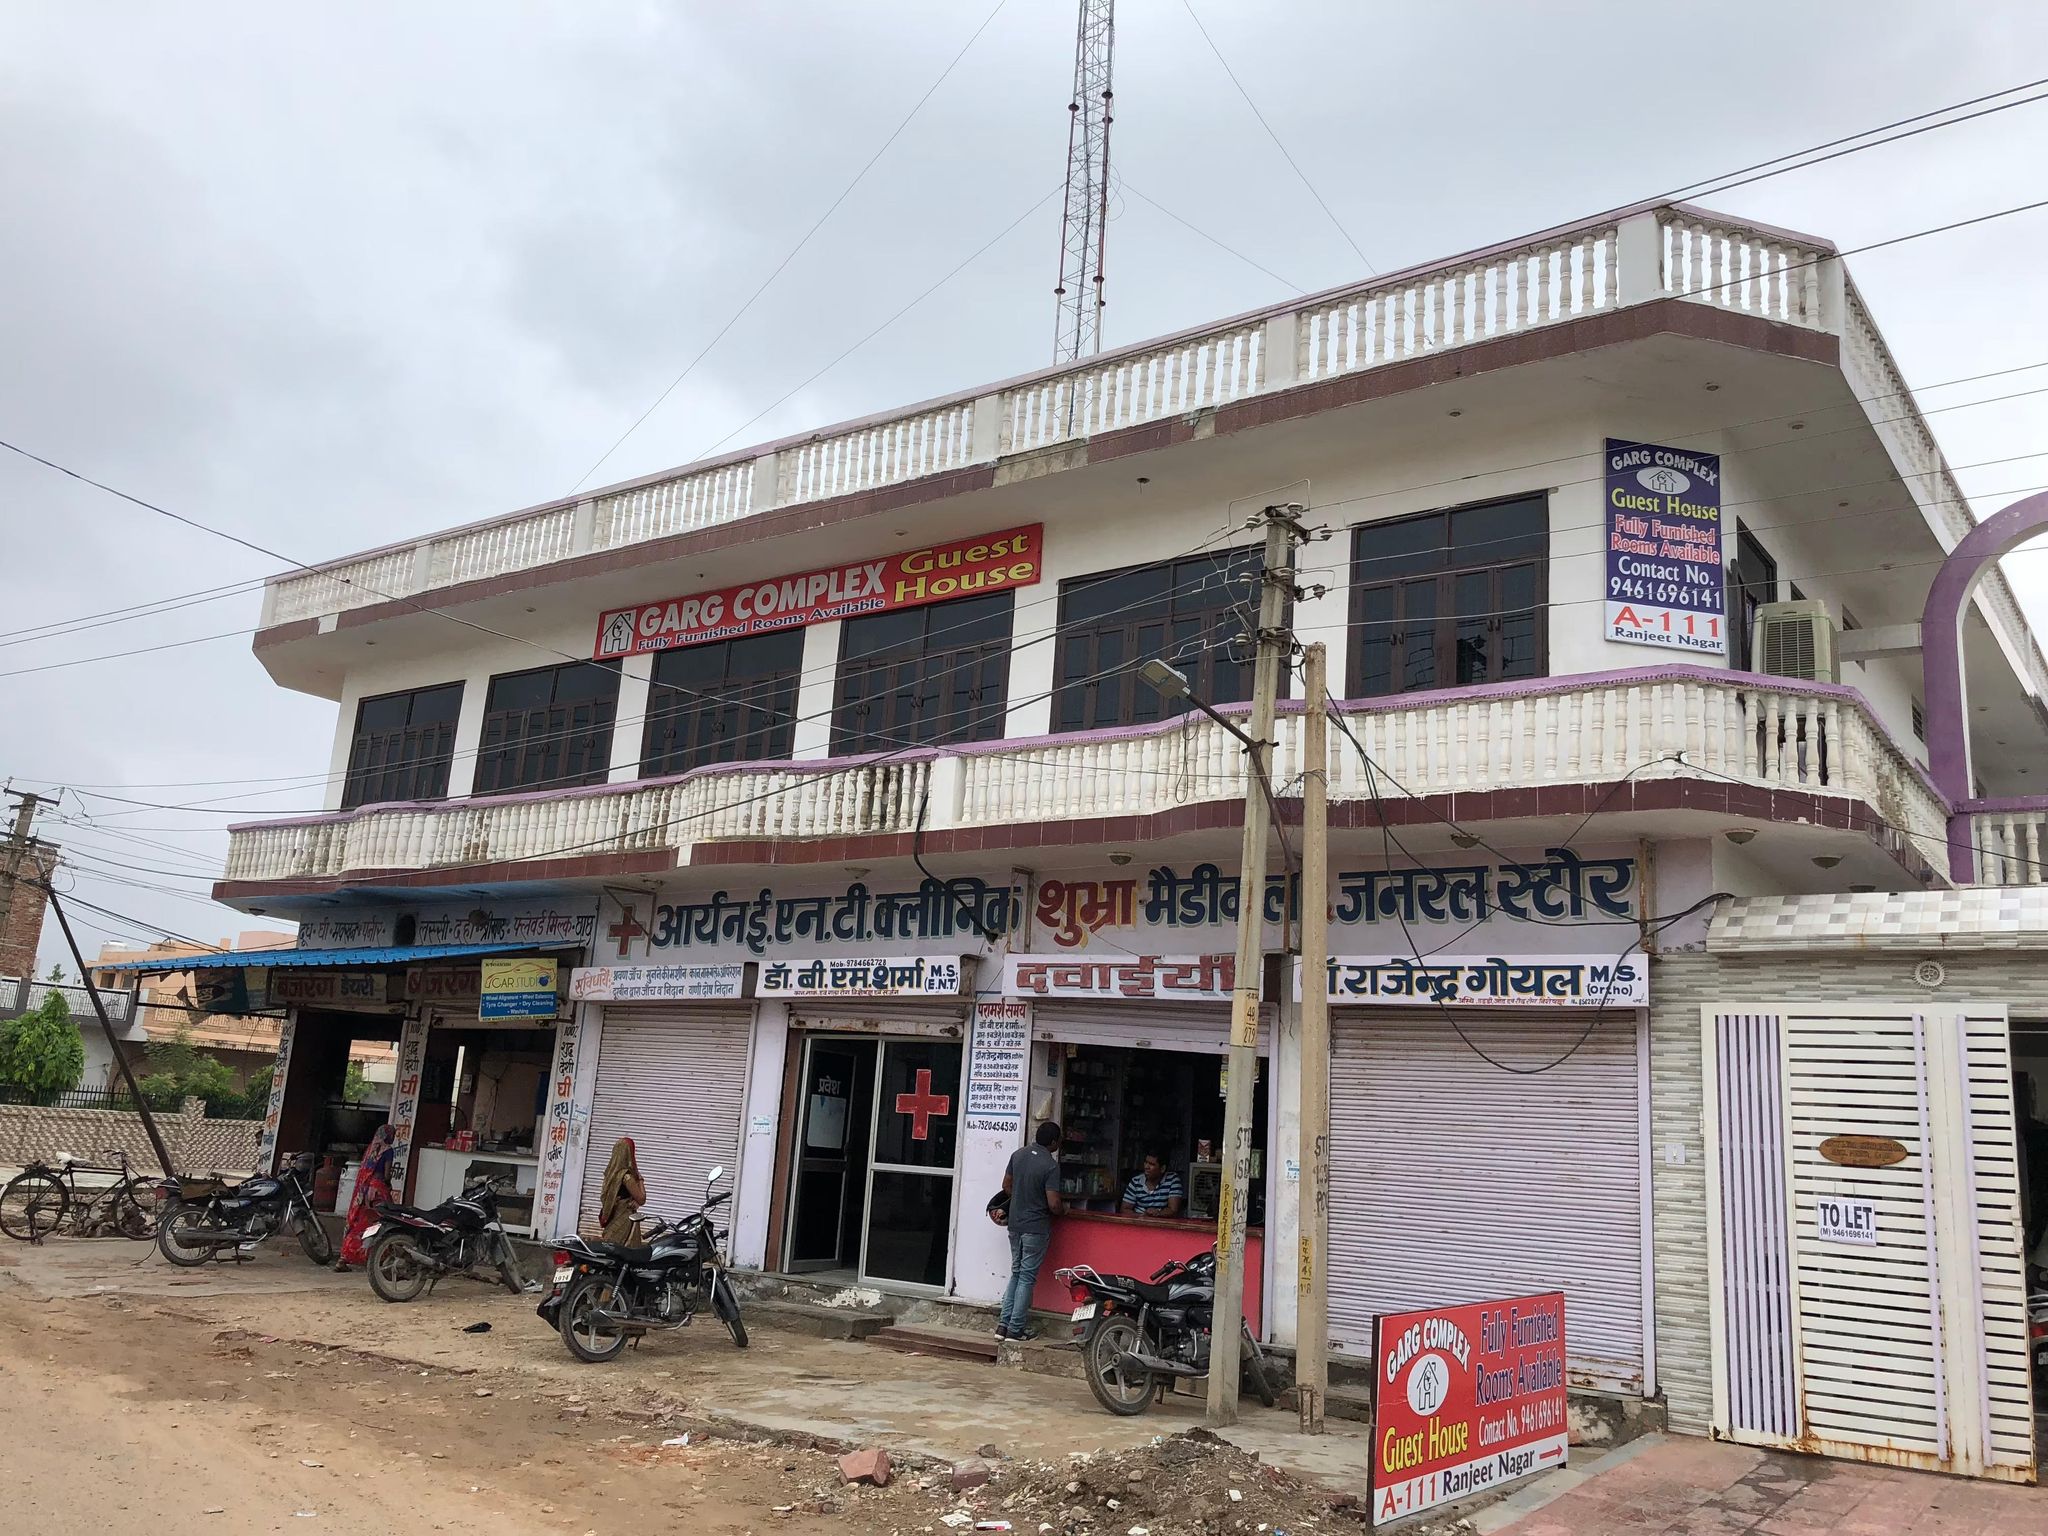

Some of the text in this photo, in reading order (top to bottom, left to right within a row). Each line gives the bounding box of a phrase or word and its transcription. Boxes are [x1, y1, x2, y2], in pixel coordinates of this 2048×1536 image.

[1611, 450, 1719, 487] GARG COMPLEX
[1611, 487, 1718, 521] Guest House
[1615, 514, 1716, 546] Fully Furnished
[900, 532, 1031, 574] Guest
[1611, 533, 1720, 565] Rooms Available
[894, 562, 1034, 603] House
[1618, 556, 1715, 587] Contact No.
[638, 560, 887, 637] GARG COMPLEX
[1610, 577, 1721, 609] 9461696141
[637, 597, 886, 652] Fully Furnished Rooms Available
[1613, 606, 1719, 638] A-111
[1615, 626, 1723, 649] Ranjeet Nagar
[1336, 865, 1489, 922] जनरल
[1497, 848, 1635, 916] स्टोर
[492, 977, 515, 988] CAR
[1466, 957, 1585, 997] गोयल
[1006, 1004, 1026, 1018] समय
[401, 1074, 419, 1096] घी
[557, 1075, 572, 1099] घी
[1820, 1203, 1873, 1230] TO LET
[1820, 1228, 1873, 1240] (M) 9461696141
[1480, 1301, 1559, 1360] Fully Furnished
[1386, 1316, 1471, 1384] GARG COMPLEX
[1475, 1347, 1561, 1408] Rooms Available
[1479, 1396, 1563, 1447] Contact No. 9461696141
[1383, 1416, 1468, 1474] Guest House
[1381, 1449, 1535, 1519] A-111 Ranjeet Nagar
